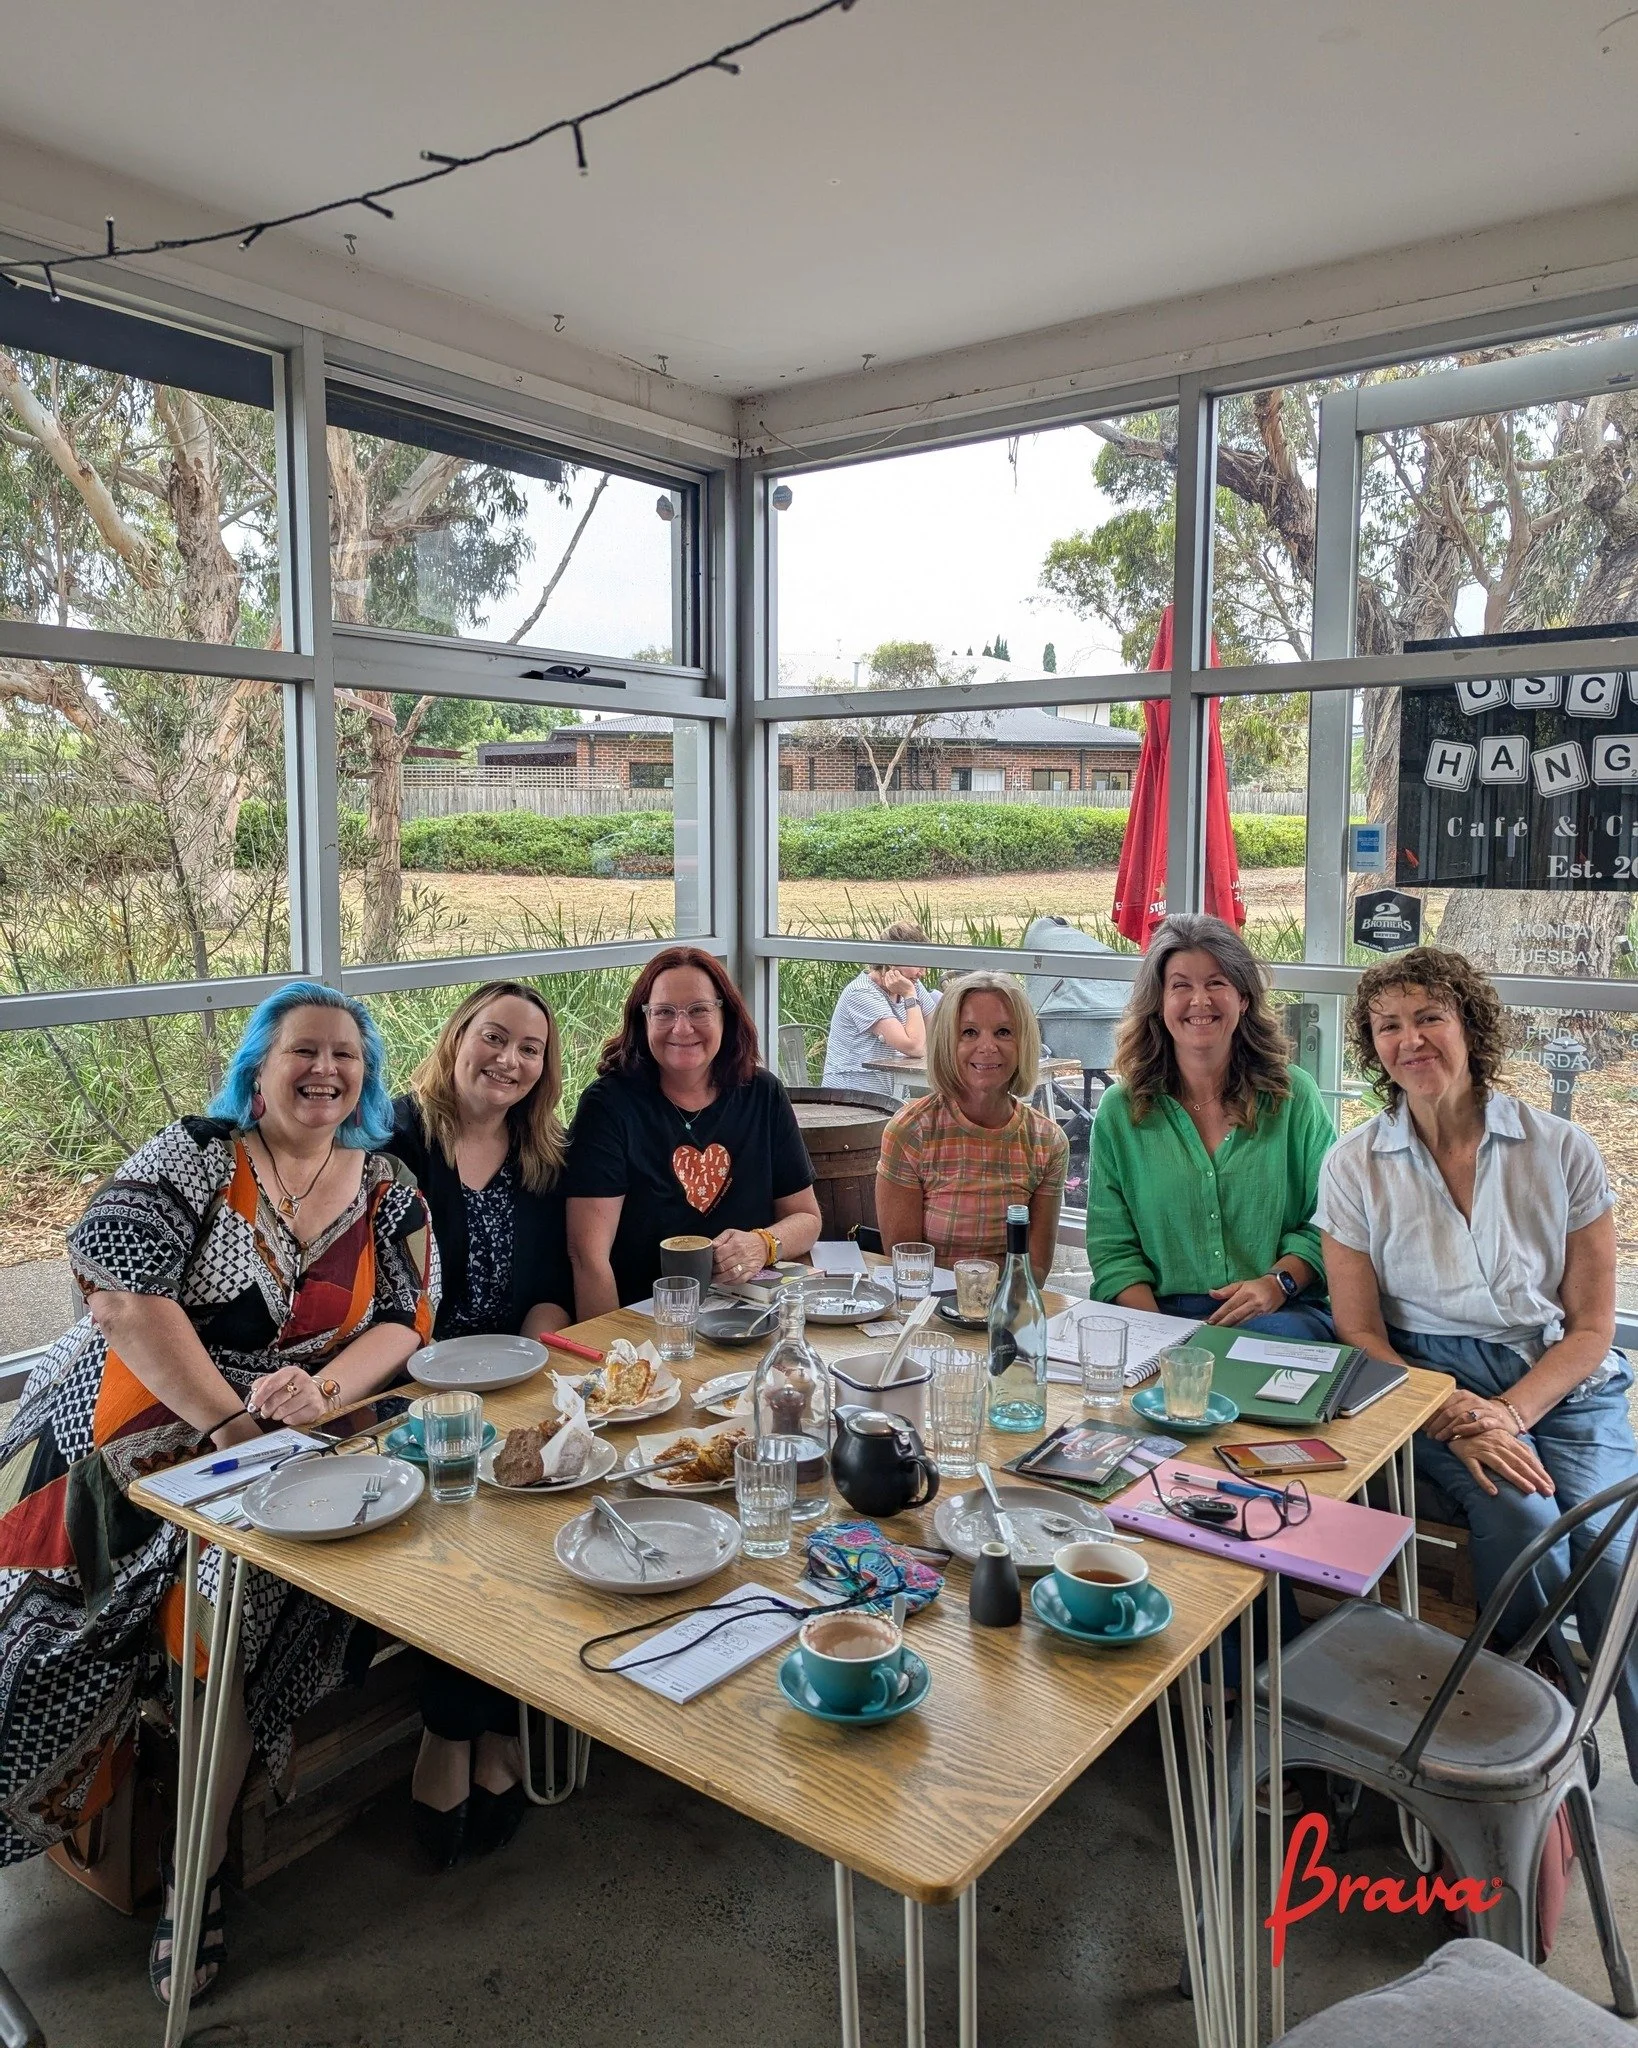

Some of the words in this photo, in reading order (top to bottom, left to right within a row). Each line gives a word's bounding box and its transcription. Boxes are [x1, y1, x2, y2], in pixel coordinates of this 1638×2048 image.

[1437, 744, 1631, 783] HANG
[1447, 815, 1528, 837] Café
[1553, 815, 1579, 837] &
[1547, 854, 1603, 879] Est.
[1372, 902, 1402, 921] 2
[1361, 918, 1412, 932] BROTHERS
[1515, 923, 1600, 940] MONDAY
[1507, 947, 1600, 967] TUESDAY
[1526, 1025, 1597, 1044] FRIDAY
